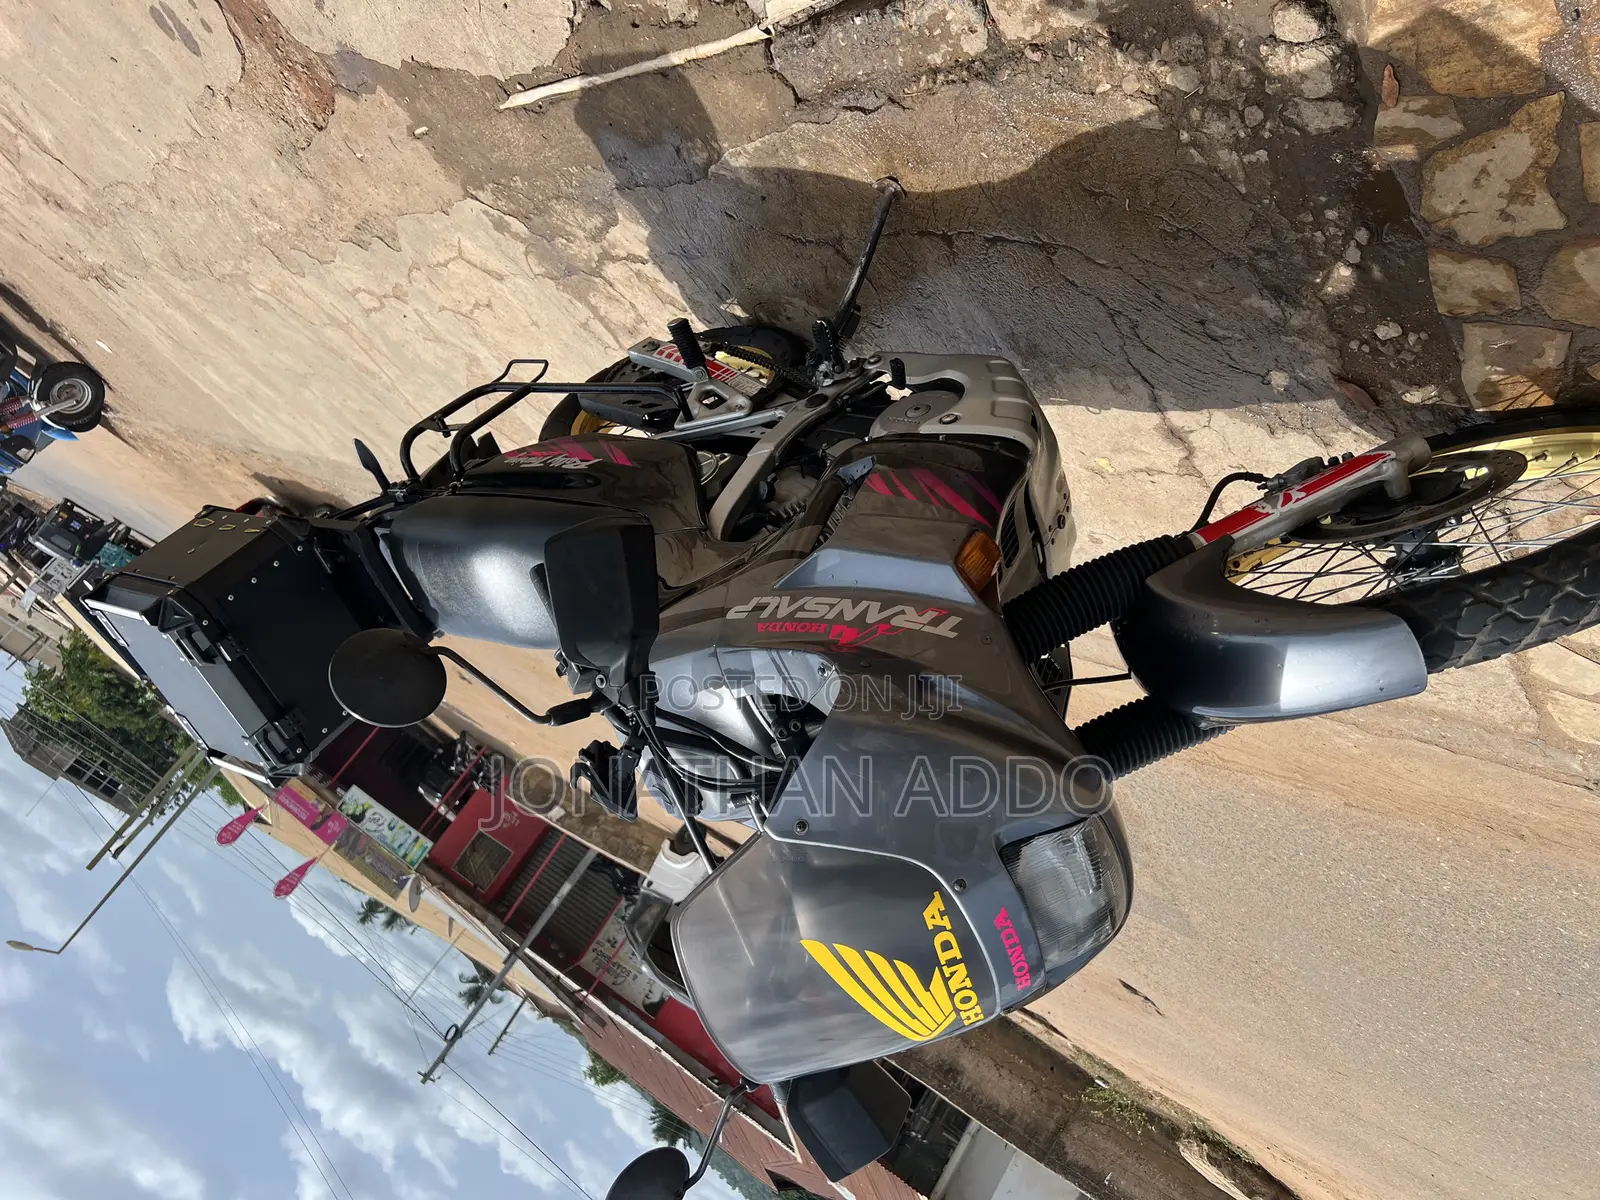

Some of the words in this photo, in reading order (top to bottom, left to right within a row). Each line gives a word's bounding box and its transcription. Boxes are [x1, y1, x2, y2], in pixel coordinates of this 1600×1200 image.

[726, 596, 963, 638] TRANSALP
[756, 621, 828, 633] HONDA
[923, 891, 984, 1026] HONDA
[994, 907, 1031, 992] HONDA
